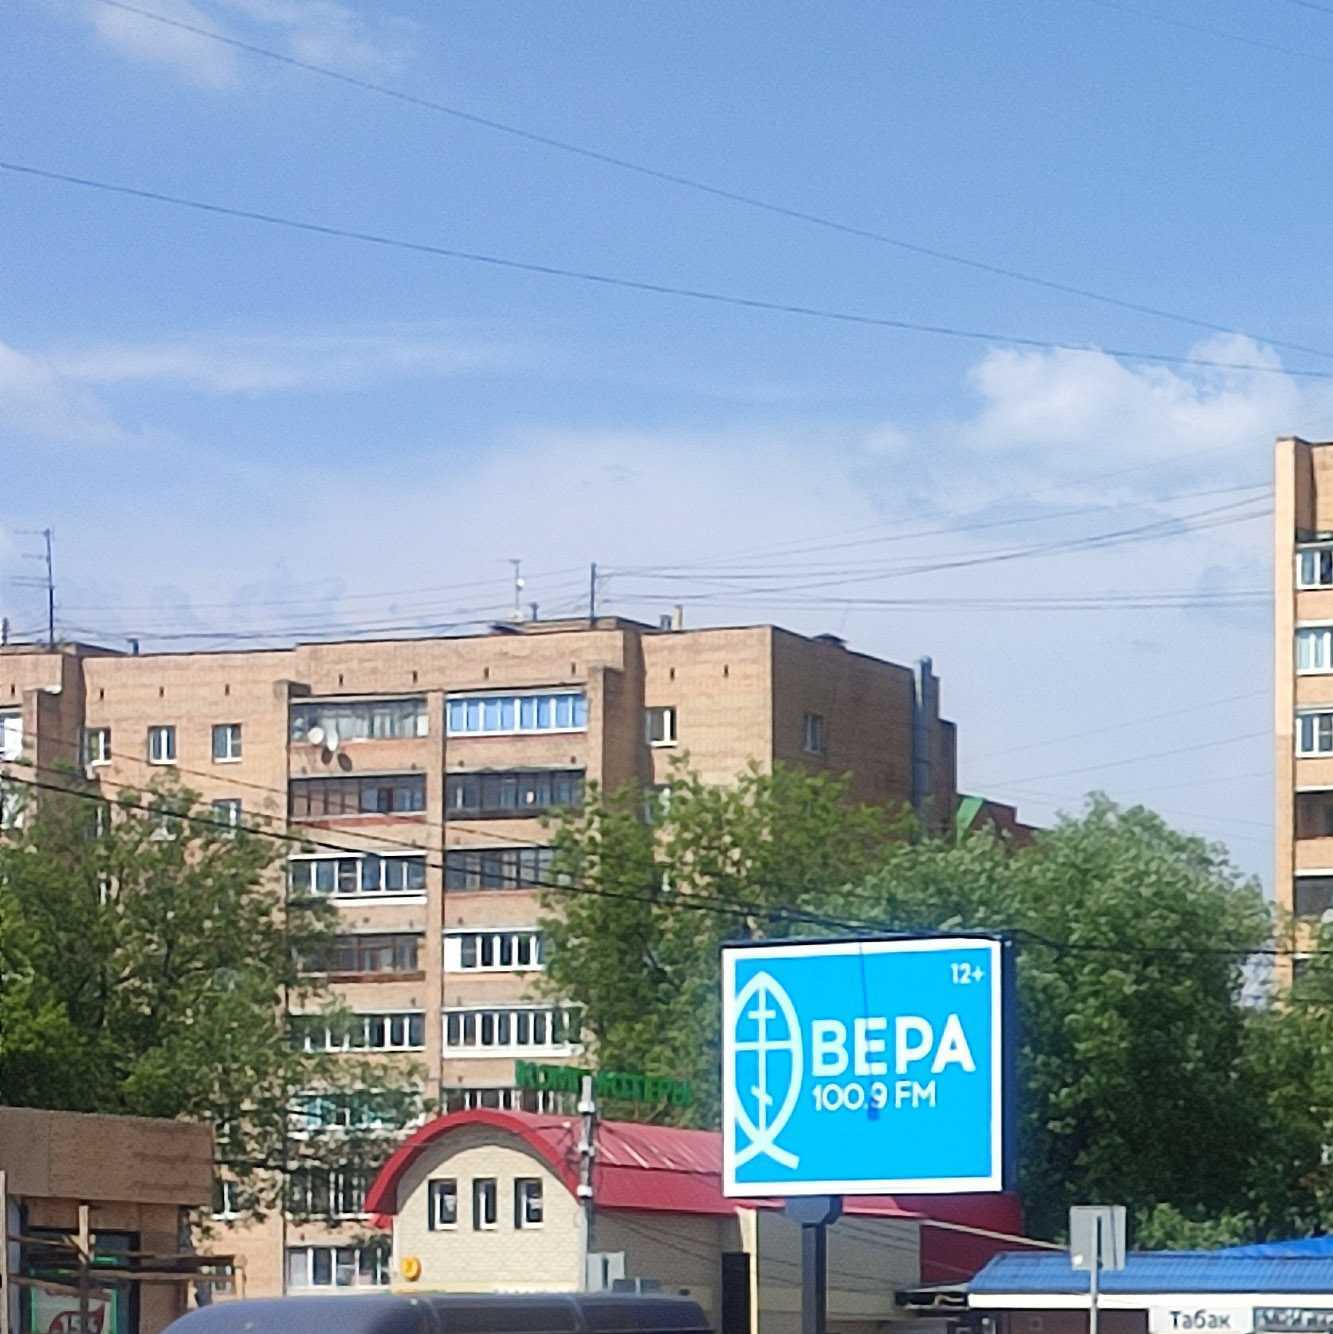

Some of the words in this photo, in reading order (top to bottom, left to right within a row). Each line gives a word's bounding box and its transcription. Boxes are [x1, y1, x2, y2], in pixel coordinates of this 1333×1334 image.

[950, 962, 985, 985] 12+
[811, 1013, 977, 1078] ВЕРА
[514, 1059, 693, 1106] КОМПЮТЕРЫ
[812, 1081, 888, 1112] 100.9
[895, 1080, 937, 1109] FM
[1170, 1309, 1232, 1329] Табак
